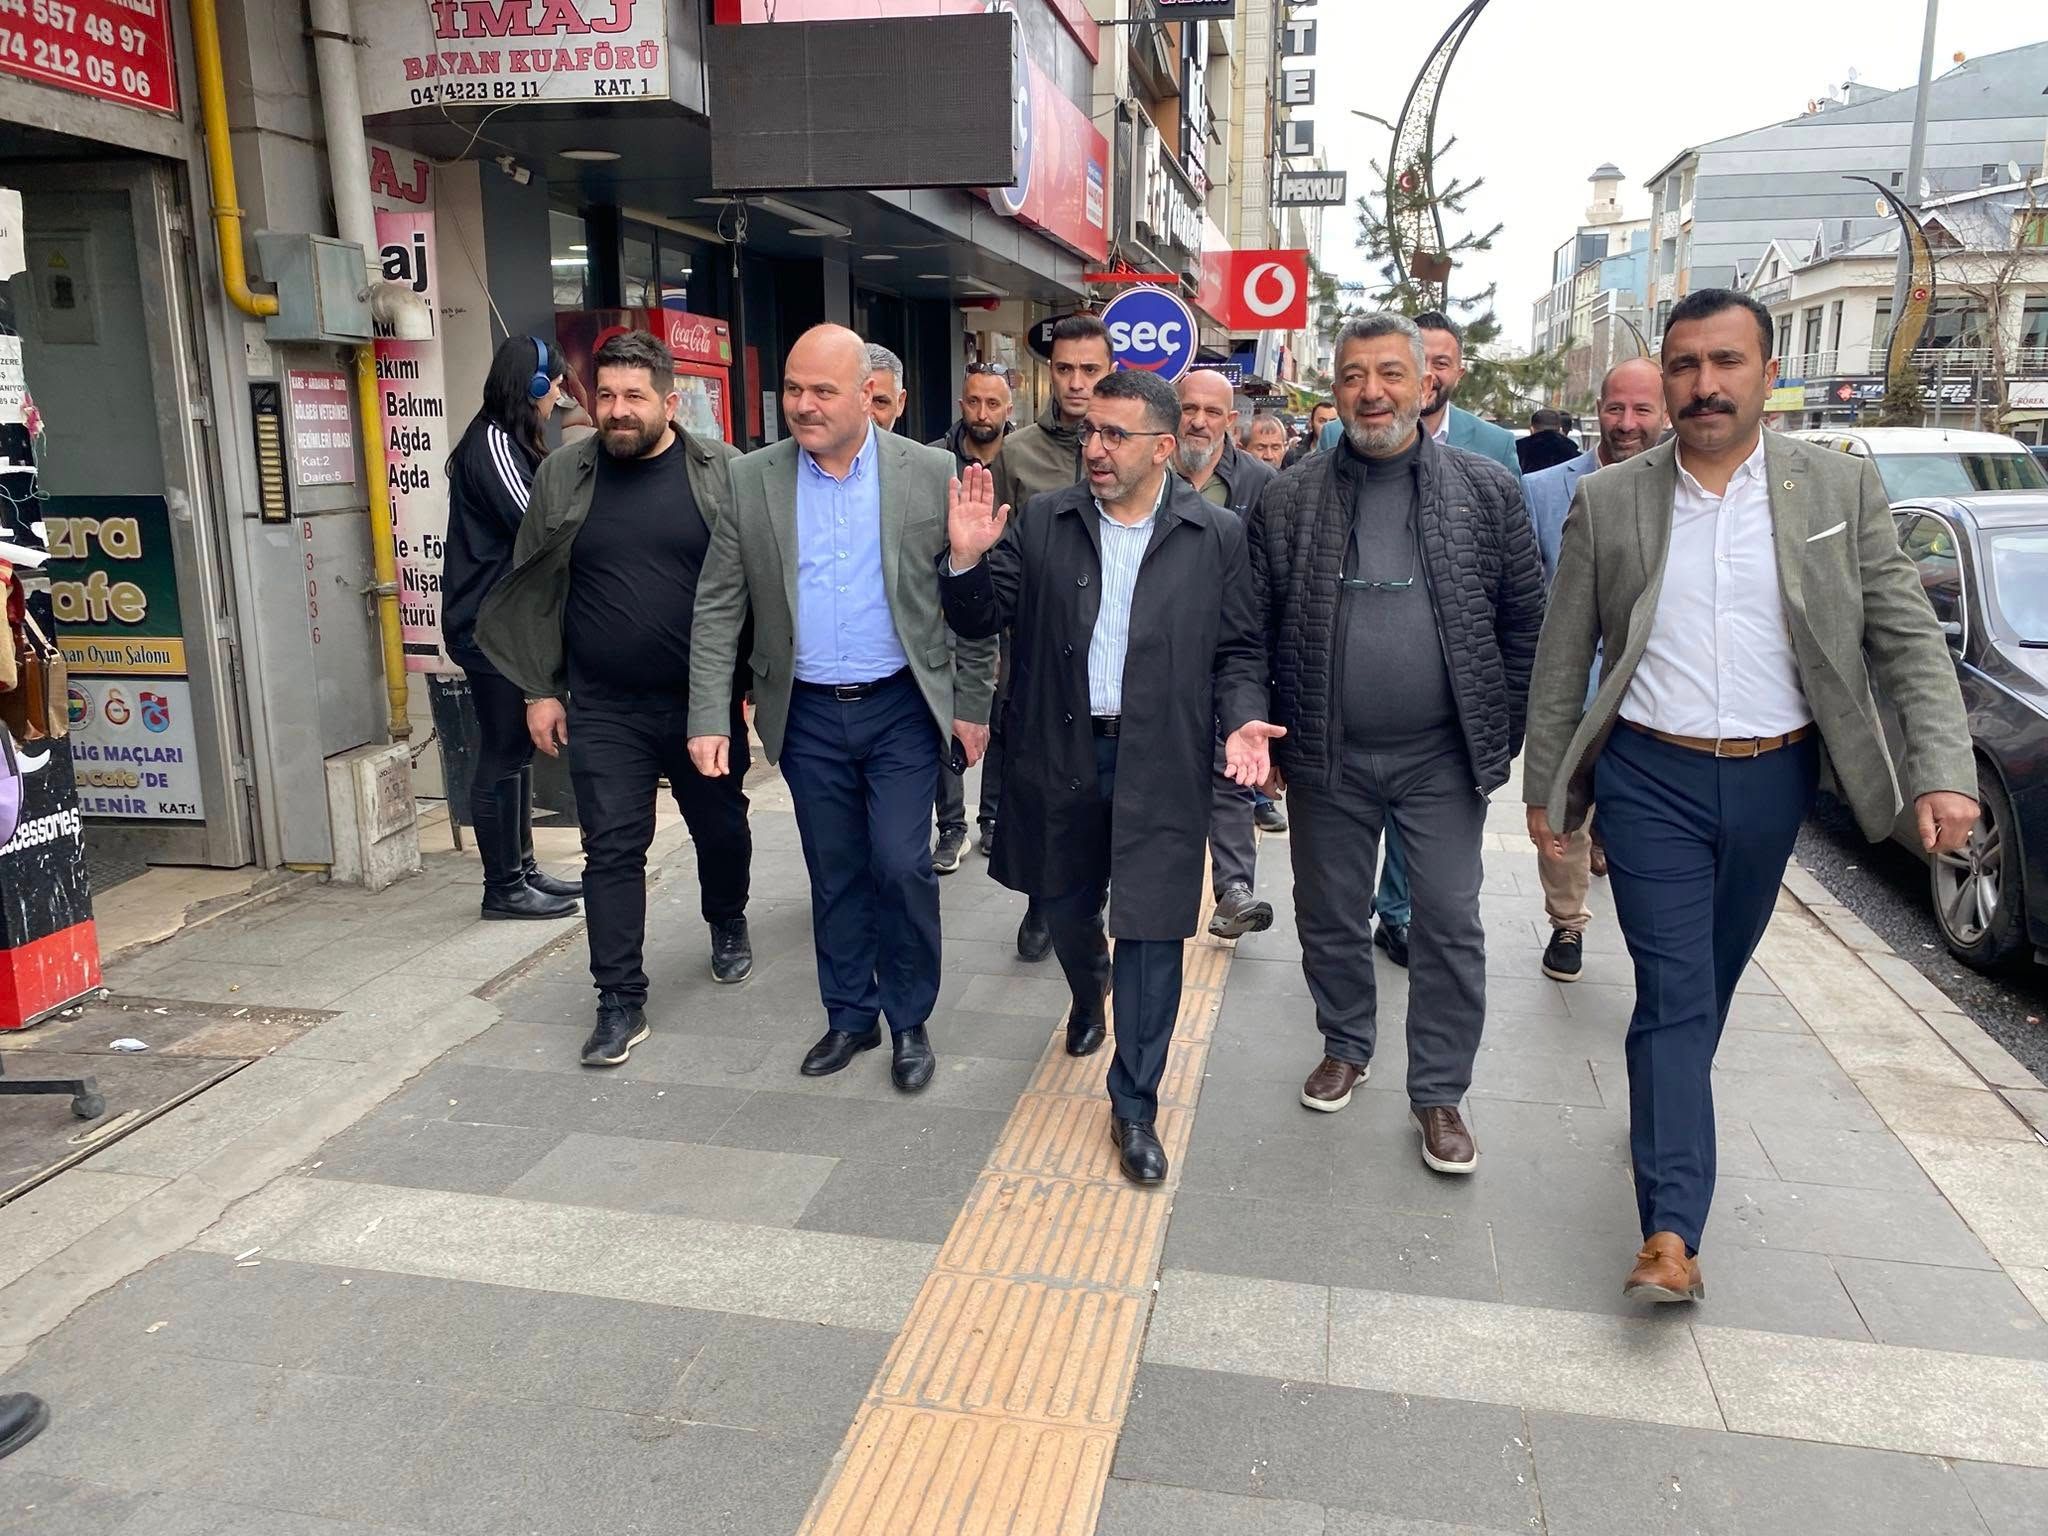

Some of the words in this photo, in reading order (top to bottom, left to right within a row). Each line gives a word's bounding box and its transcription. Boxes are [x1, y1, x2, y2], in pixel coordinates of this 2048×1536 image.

[33, 0, 77, 34] 557
[84, 13, 114, 46] 48
[119, 25, 146, 57] 97
[0, 28, 28, 61] 74
[33, 38, 80, 78] 212
[86, 55, 117, 87] 05
[121, 66, 150, 97] 06
[403, 51, 500, 81] BAYAN
[508, 40, 660, 73] KUAFÖRÜ
[493, 81, 516, 99] 82
[521, 80, 540, 98] 11
[594, 79, 635, 96] KAT.
[641, 78, 650, 95] 1
[1286, 0, 1313, 154] TEL
[371, 147, 430, 204] AJ
[1282, 174, 1344, 202] İPEKYOLU
[381, 232, 428, 293] aj
[671, 319, 711, 354] Coca-Cola
[1109, 321, 1182, 356] seç
[376, 360, 419, 380] akımı
[386, 391, 444, 417] Bakımı
[390, 426, 431, 457] Ağda
[302, 456, 330, 466] Kat:2
[303, 472, 341, 483] Daire:5
[388, 464, 430, 494] Ağda
[423, 534, 445, 559] Fö
[51, 571, 147, 622] afe
[88, 645, 123, 664] Oyun
[126, 645, 170, 665] Salonu
[72, 741, 99, 760] LİG
[103, 745, 184, 766] MAÇLARI
[80, 794, 147, 814] LENİR
[159, 802, 196, 815] KAT:1
